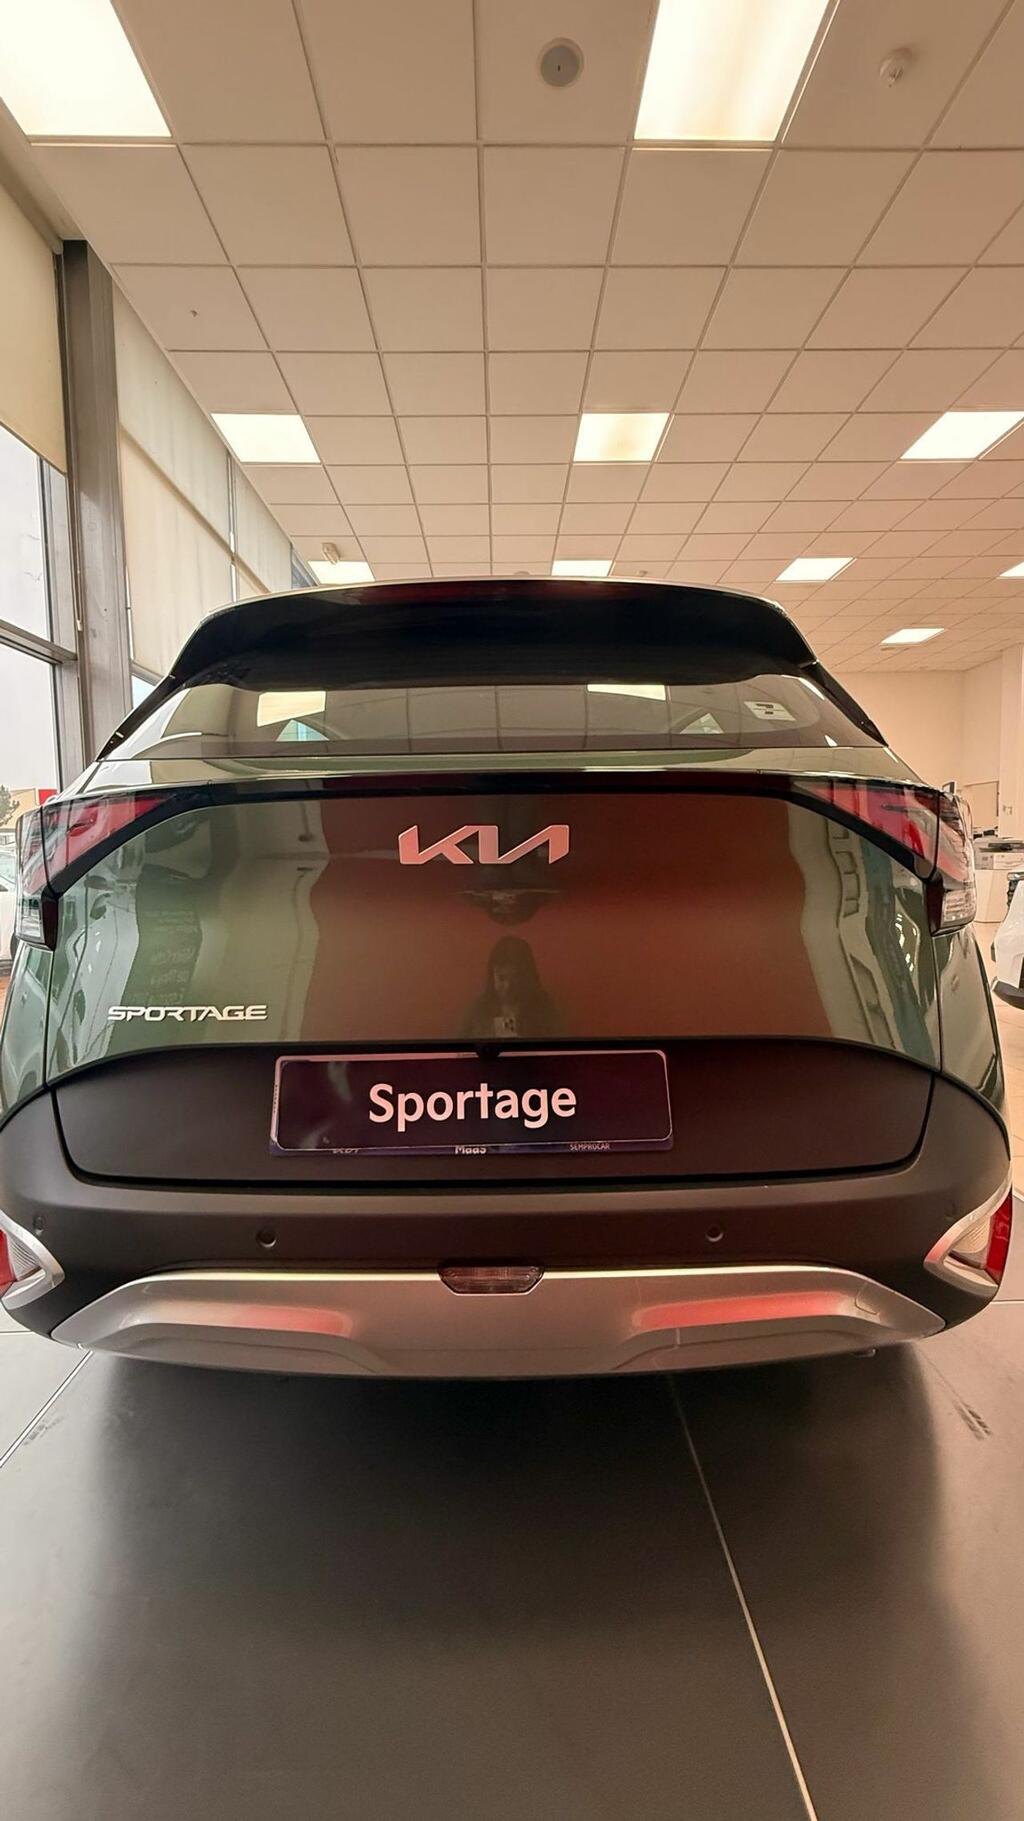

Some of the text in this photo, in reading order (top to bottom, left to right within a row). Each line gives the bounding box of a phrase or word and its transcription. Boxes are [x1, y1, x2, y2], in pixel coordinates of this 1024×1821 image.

[398, 824, 570, 865] KIA
[107, 1004, 268, 1022] SPORTAGE
[369, 1083, 577, 1132] Sportage
